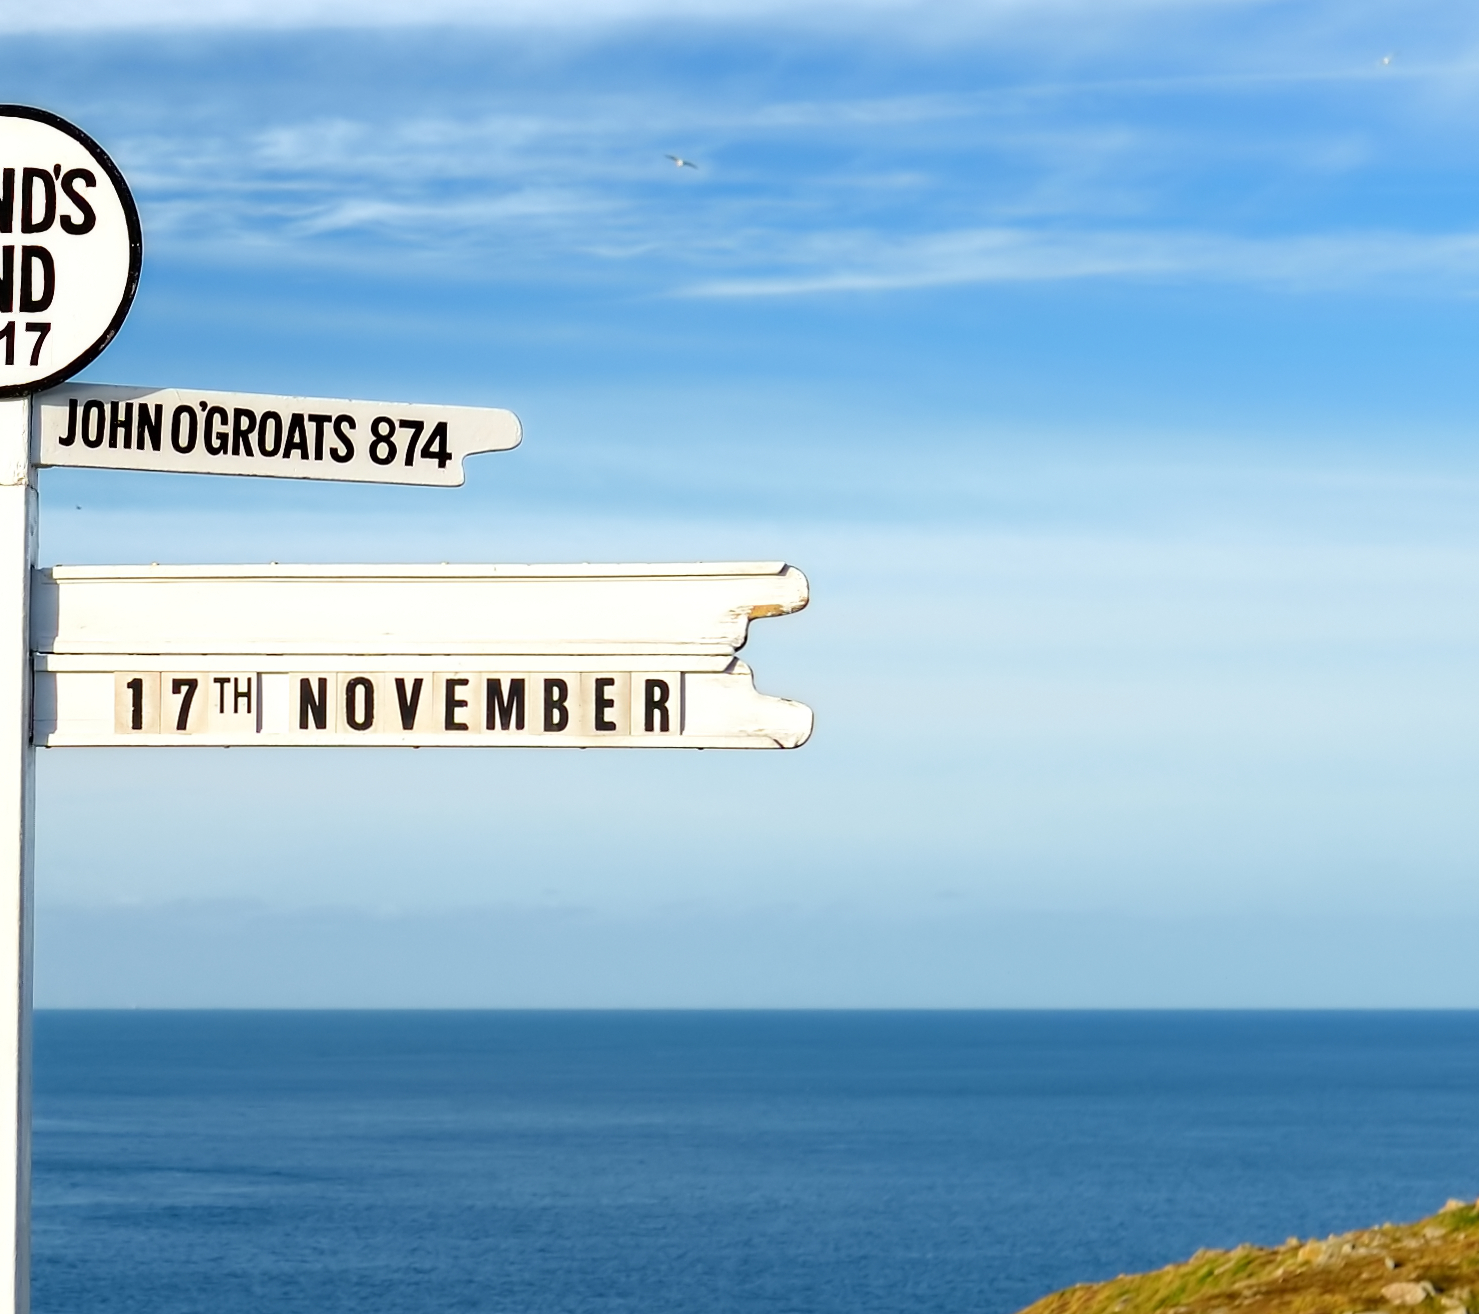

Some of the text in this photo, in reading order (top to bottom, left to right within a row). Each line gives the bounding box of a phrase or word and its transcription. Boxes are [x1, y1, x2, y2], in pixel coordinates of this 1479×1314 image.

[58, 397, 453, 469] JOHN O'GROATS 874
[299, 676, 670, 733] NOVEMBER
